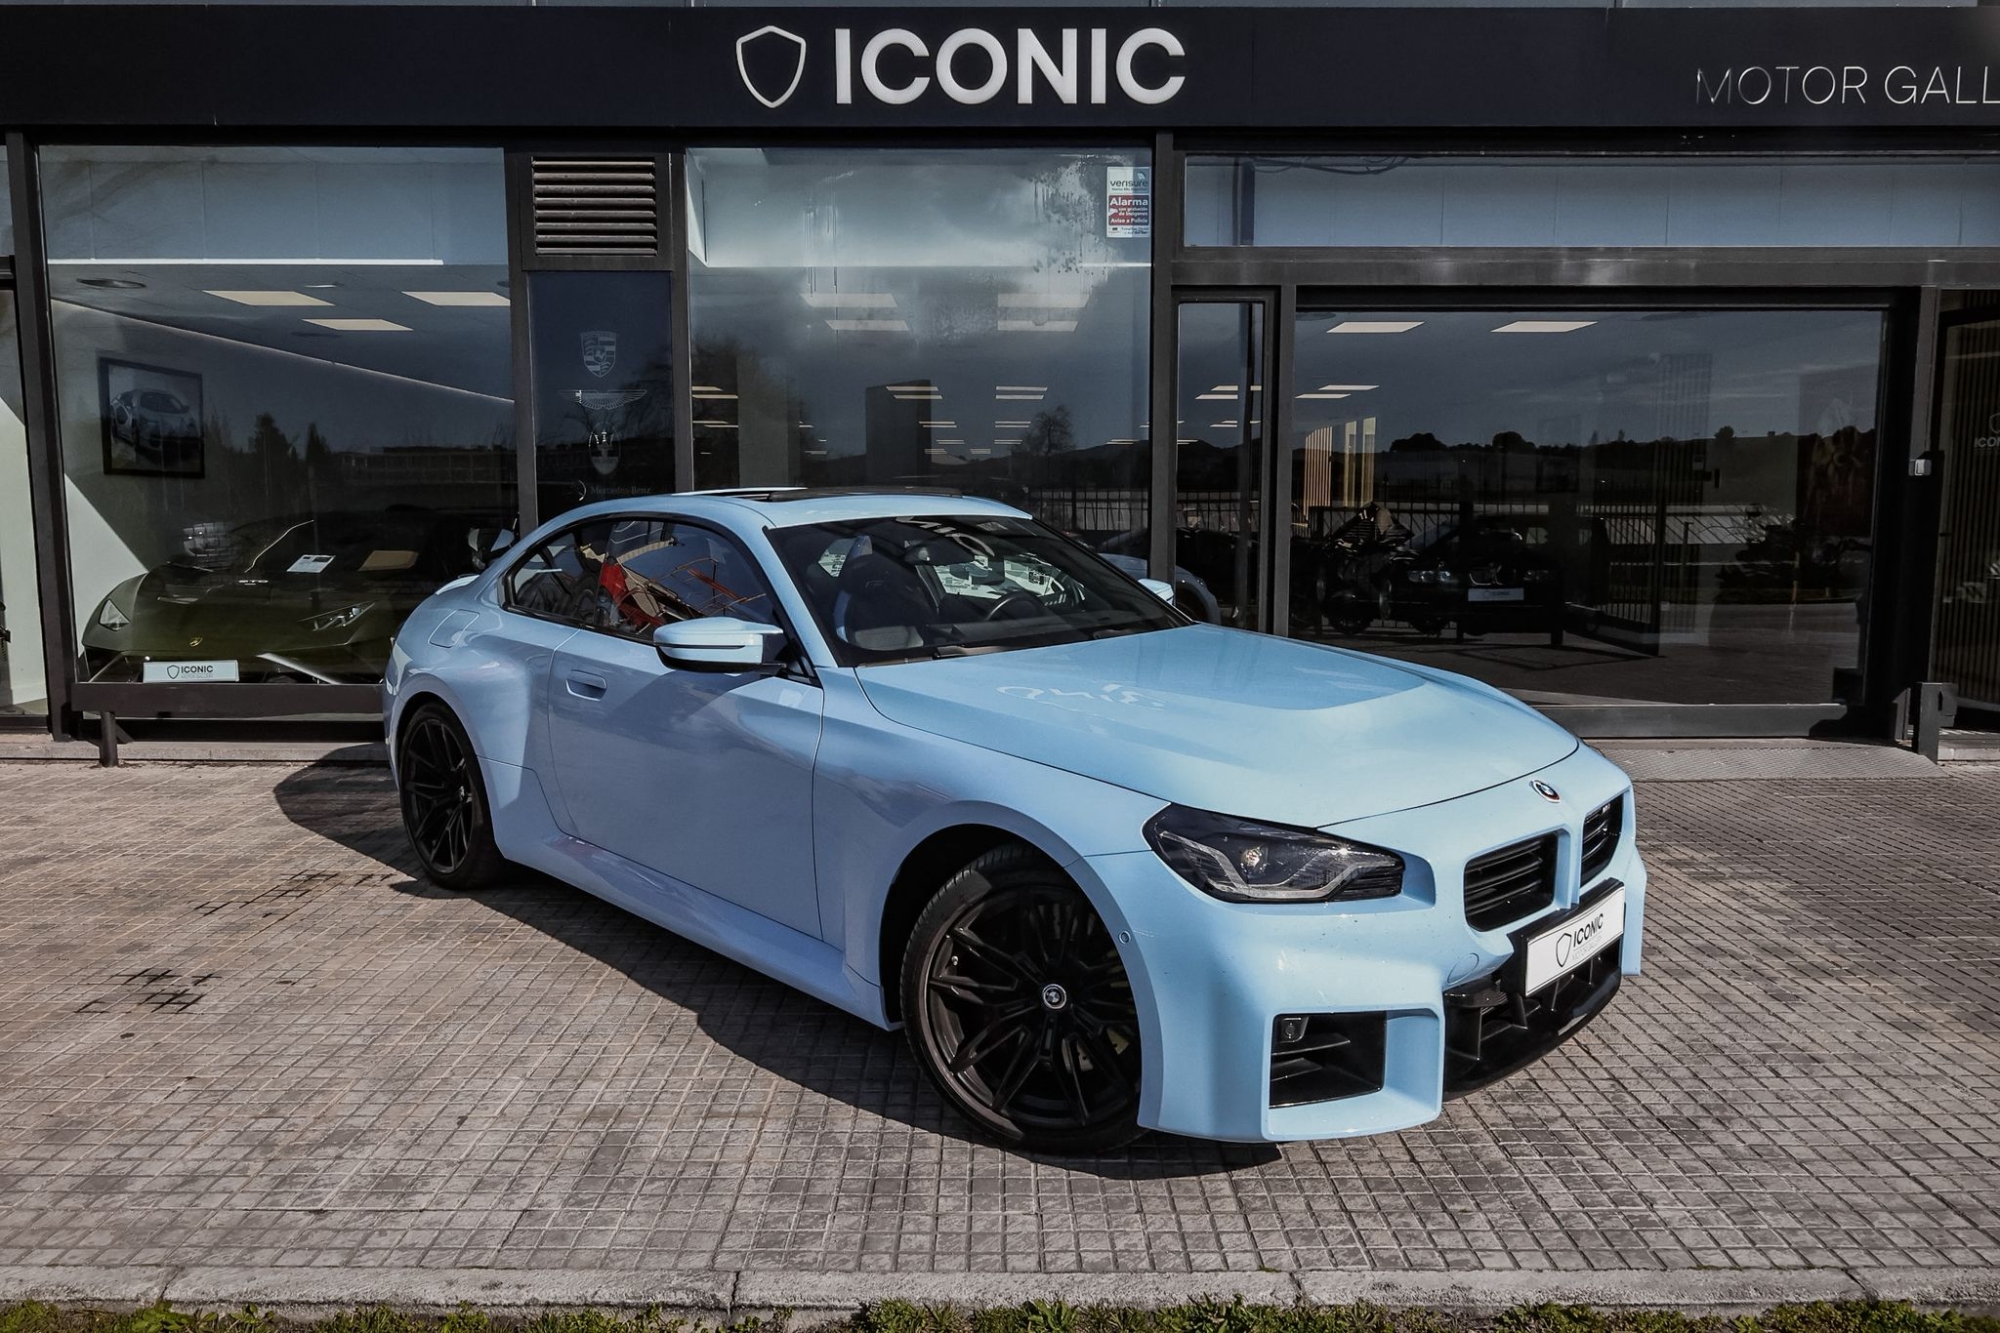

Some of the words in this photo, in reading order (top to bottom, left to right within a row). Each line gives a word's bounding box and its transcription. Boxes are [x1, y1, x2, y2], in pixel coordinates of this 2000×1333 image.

[835, 27, 1186, 105] ICONIC
[1696, 66, 1868, 105] MOTOR
[1885, 66, 2000, 105] GALL
[1110, 197, 1148, 206] Alarma
[181, 665, 213, 674] ICONIC
[1573, 913, 1603, 947] ICONIC
